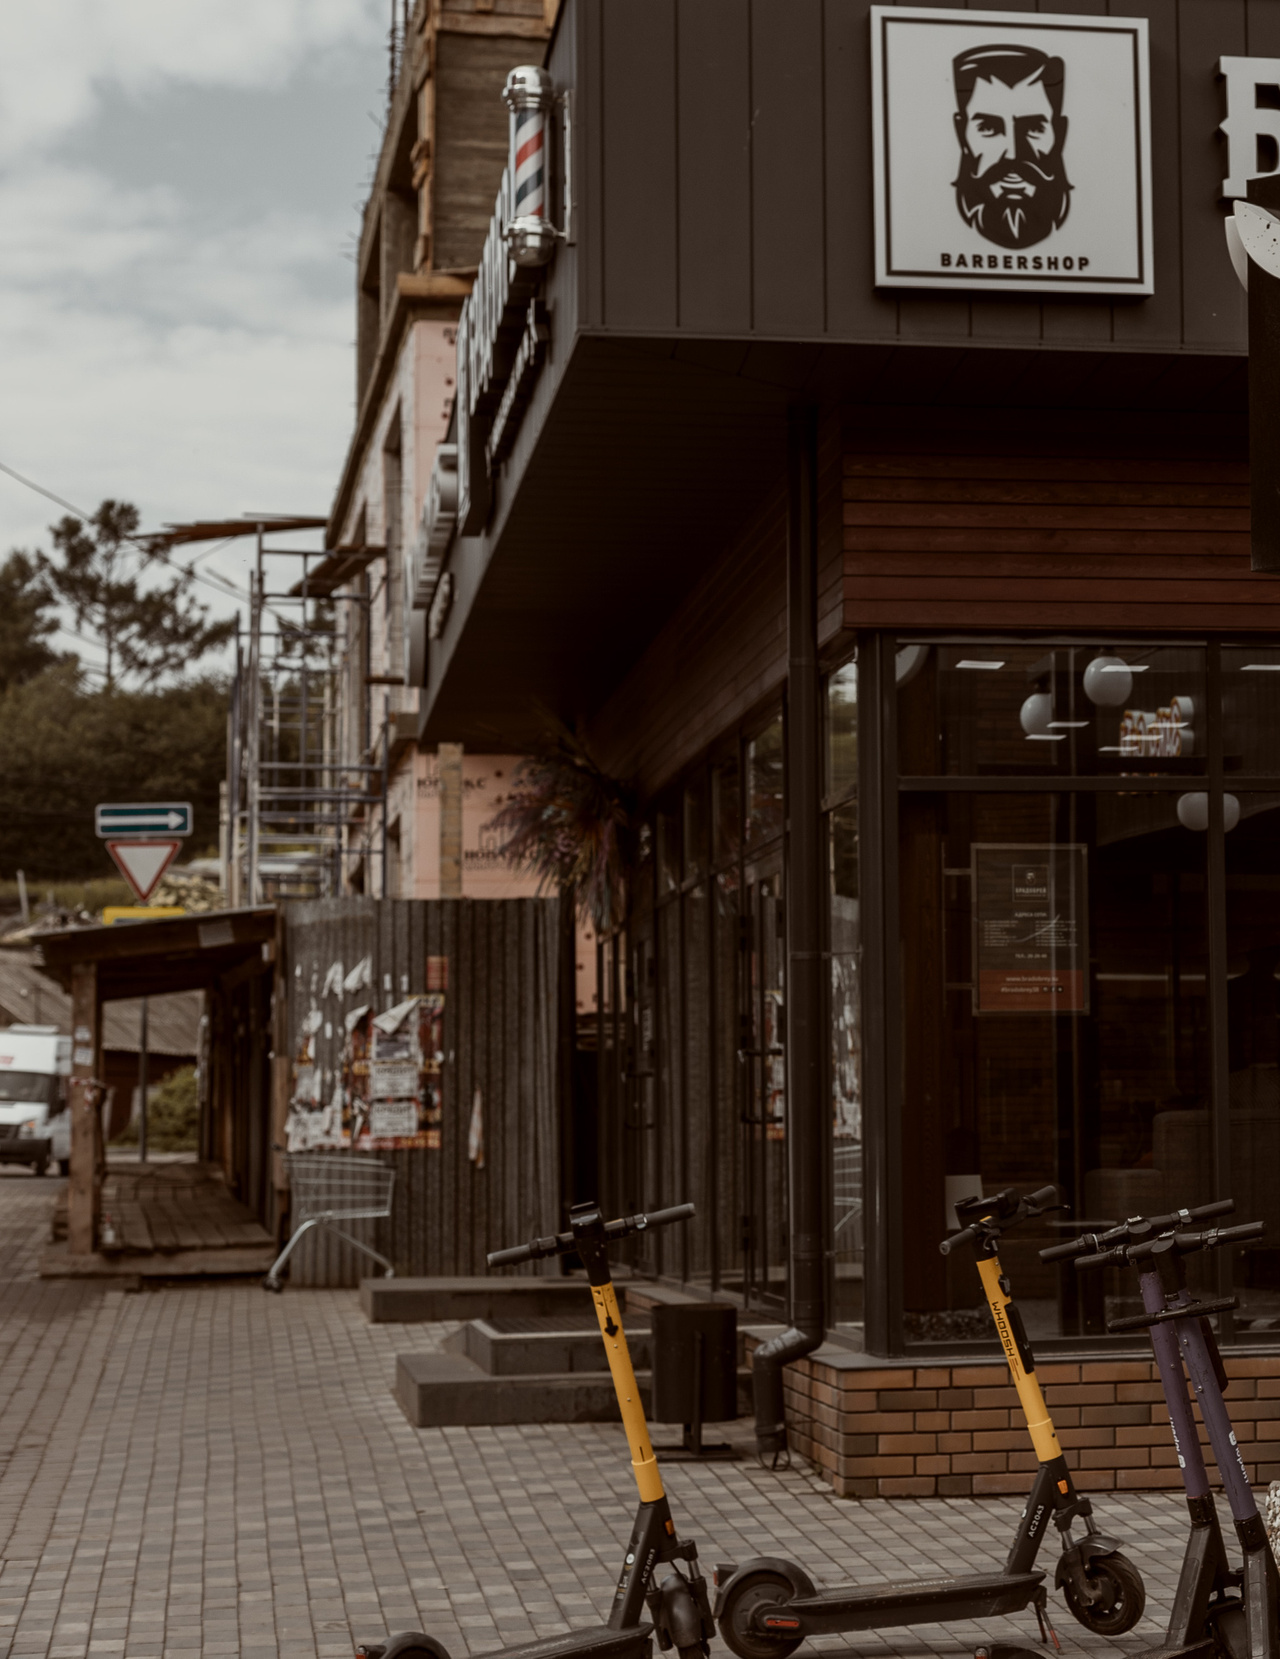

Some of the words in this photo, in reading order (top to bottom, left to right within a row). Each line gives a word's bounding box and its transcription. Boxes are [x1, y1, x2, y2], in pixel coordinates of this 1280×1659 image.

[940, 253, 1090, 271] BARBERSHOP
[991, 1301, 1015, 1358] WHOOSH
[1027, 1504, 1045, 1538] AC2043
